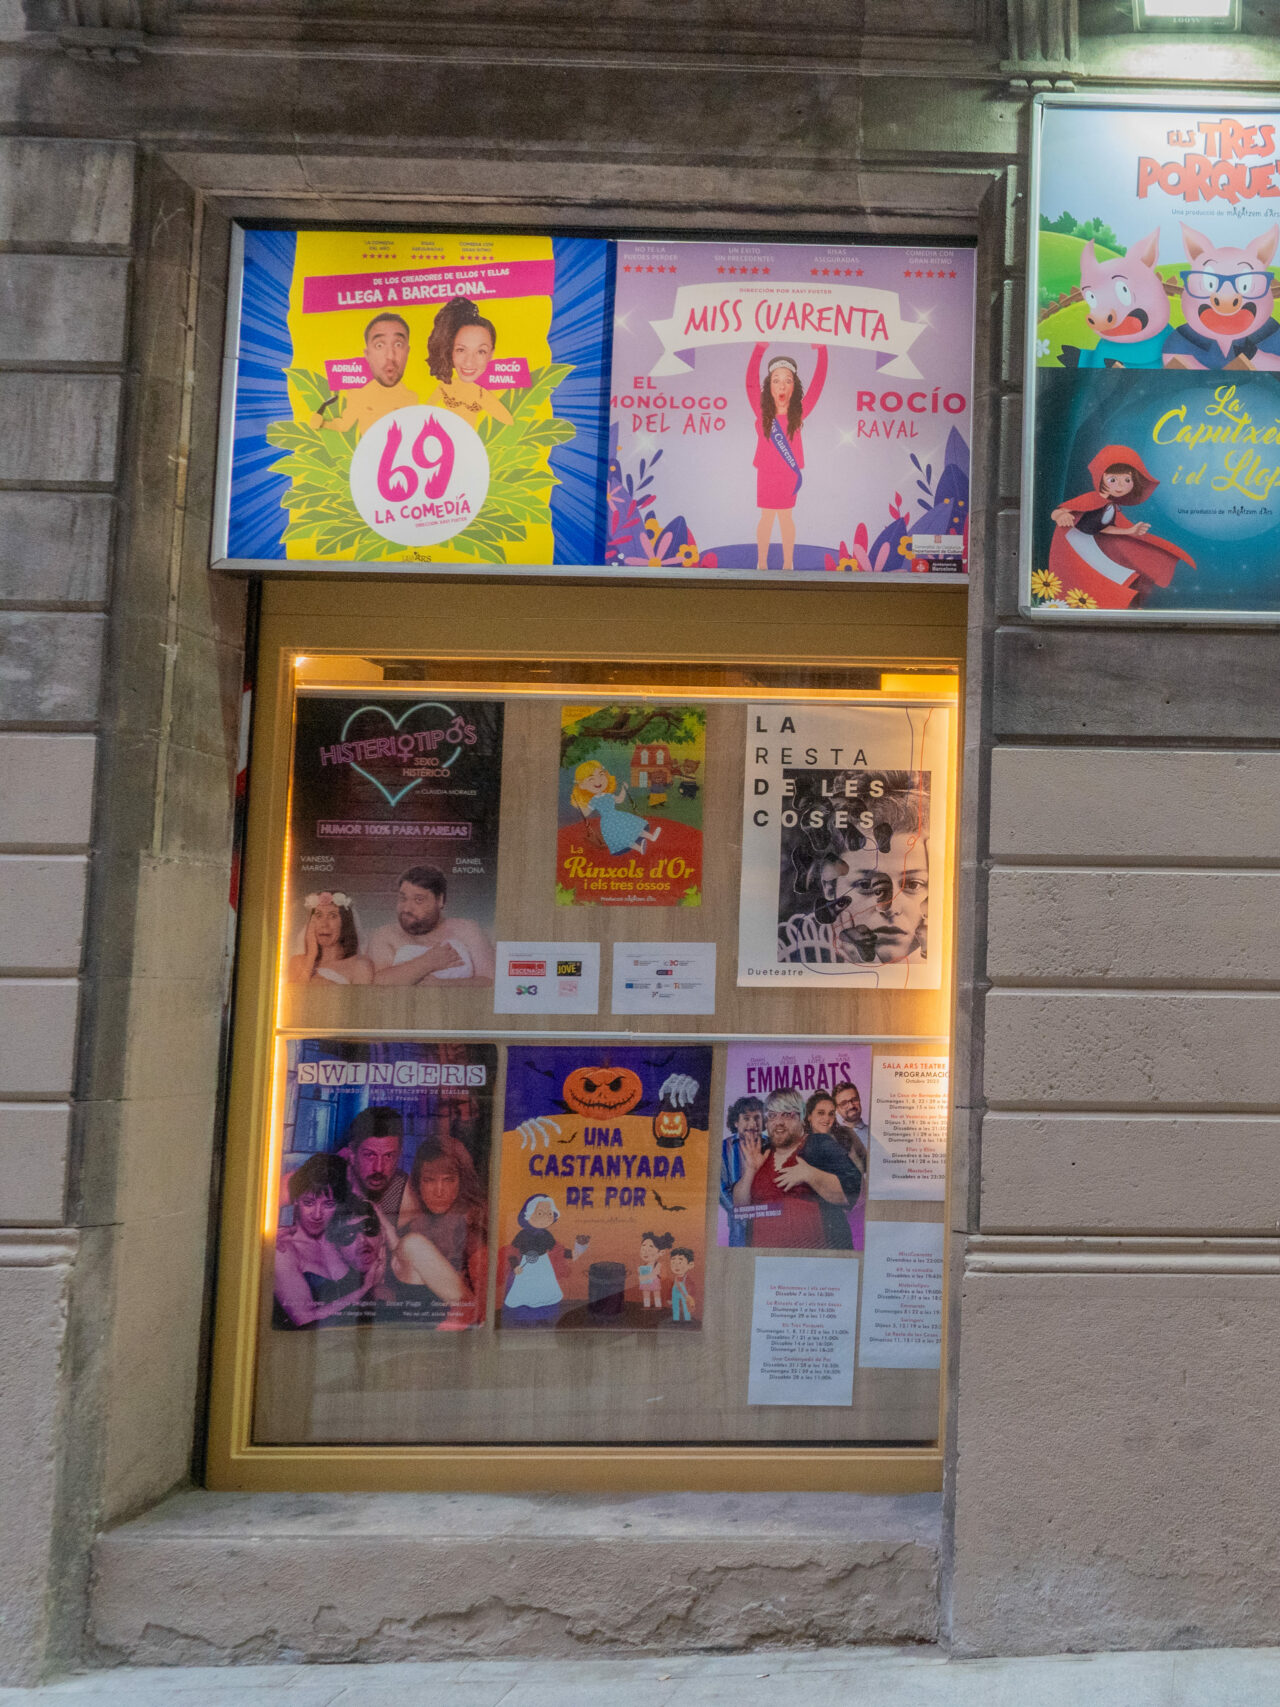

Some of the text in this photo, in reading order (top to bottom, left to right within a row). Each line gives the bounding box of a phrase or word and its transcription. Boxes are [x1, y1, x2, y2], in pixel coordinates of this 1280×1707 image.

[1197, 118, 1276, 161] TRES
[373, 278, 383, 286] DE
[385, 277, 399, 285] LOS
[401, 274, 442, 284] CREADORES
[455, 270, 478, 279] ELLOS
[487, 268, 509, 277] ELLAS
[337, 281, 496, 305] LLEGA A BARCELONA...
[684, 299, 889, 341] MISS CUARENTA
[332, 362, 362, 373] ADRIÁN
[494, 361, 521, 373] ROCÍO
[342, 375, 367, 384] RIDAO
[489, 375, 516, 384] RAVAL
[633, 376, 657, 390] EL
[856, 387, 967, 414] ROCÍO
[1205, 385, 1247, 422] La
[632, 412, 727, 435] DEL AÑO
[857, 419, 919, 439] RAVAL
[377, 413, 455, 502] 69
[774, 433, 796, 468] Cuarenta
[1172, 466, 1182, 484] i
[1185, 463, 1207, 485] el
[375, 509, 396, 524] LA
[755, 715, 796, 733] LA
[414, 757, 439, 766] SEXO
[755, 747, 868, 766] RESTA
[402, 767, 450, 777] HISTÉRICO
[754, 778, 885, 797] DE LES
[753, 810, 874, 829] COSES
[320, 824, 468, 836] HUMOR 100% PARA PAREJAS
[570, 844, 584, 854] La
[300, 855, 335, 863] VANESSA
[563, 856, 695, 879] Rínxols d'Or
[584, 879, 587, 890] i
[590, 879, 608, 890] els
[610, 881, 633, 890] tres
[557, 964, 577, 974] JOVE
[747, 968, 804, 977] Dueteatre
[299, 1062, 485, 1085] SWINGERS
[747, 1062, 852, 1094] EMMARATS
[584, 1127, 623, 1147] UNA
[528, 1154, 686, 1179] CASTANYADA
[566, 1186, 647, 1207] DE POR
